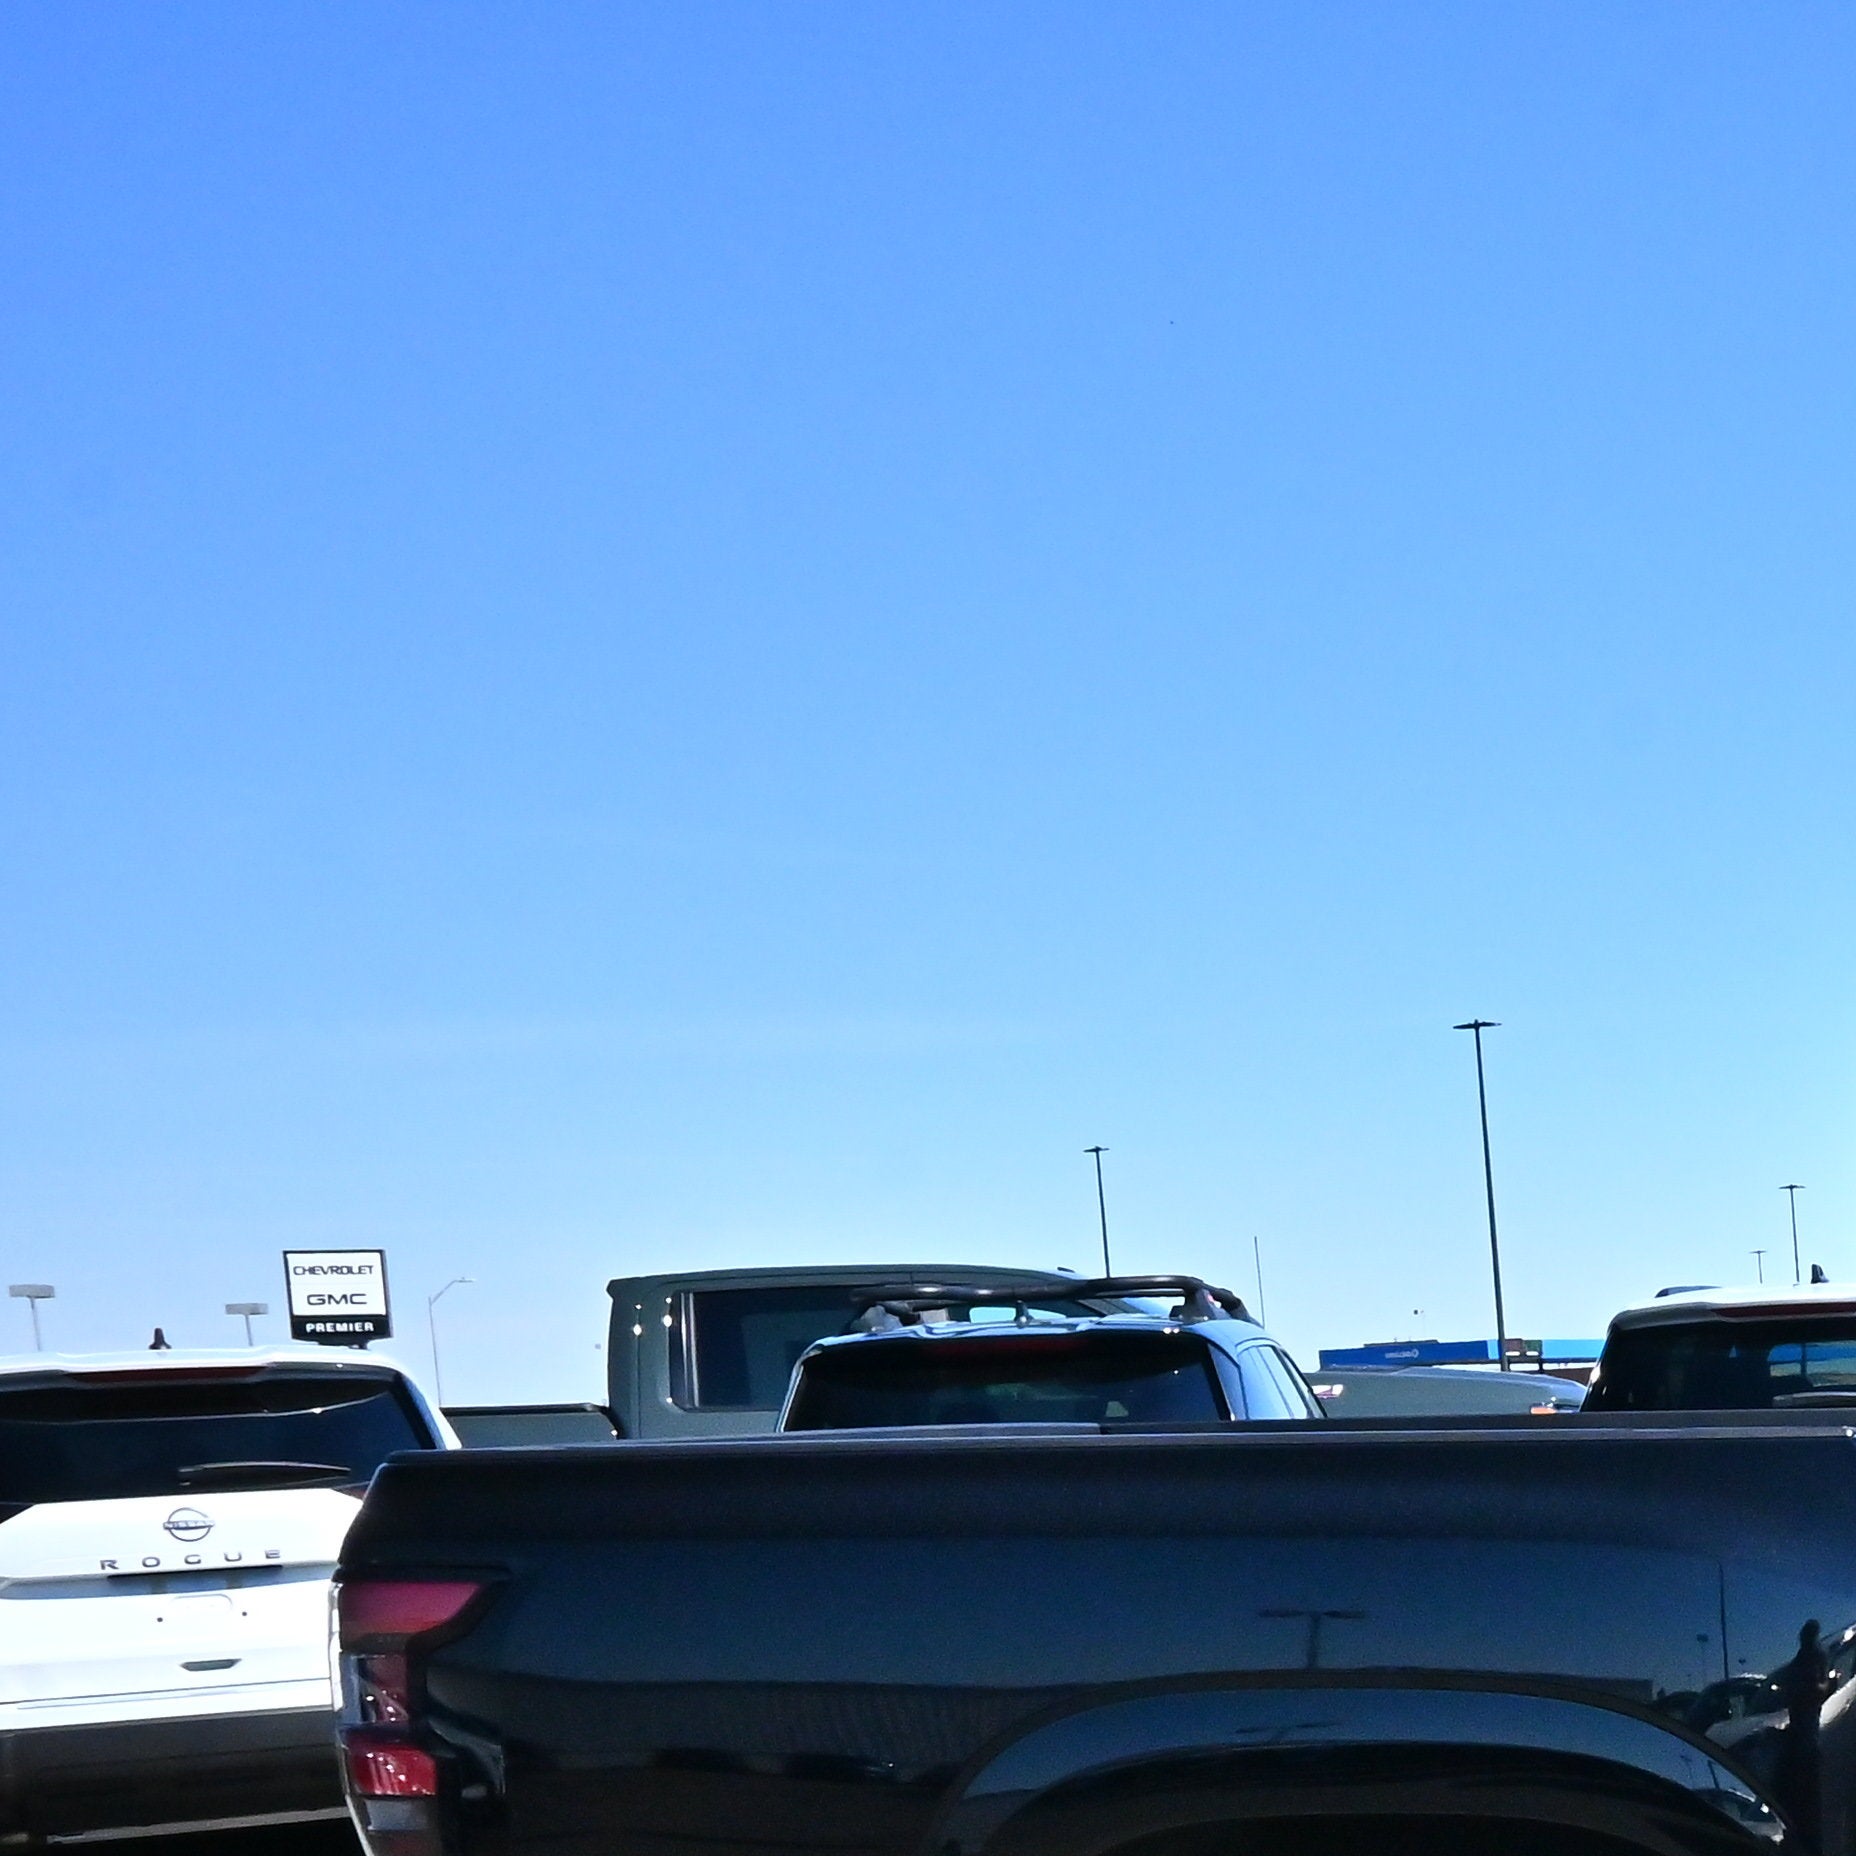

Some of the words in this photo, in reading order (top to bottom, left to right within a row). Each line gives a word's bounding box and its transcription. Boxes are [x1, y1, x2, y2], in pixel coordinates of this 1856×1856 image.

[293, 1265, 374, 1275] CHEVROLET
[307, 1293, 367, 1306] GMC
[305, 1321, 374, 1333] PREMIER
[99, 1549, 281, 1571] ROGUE
